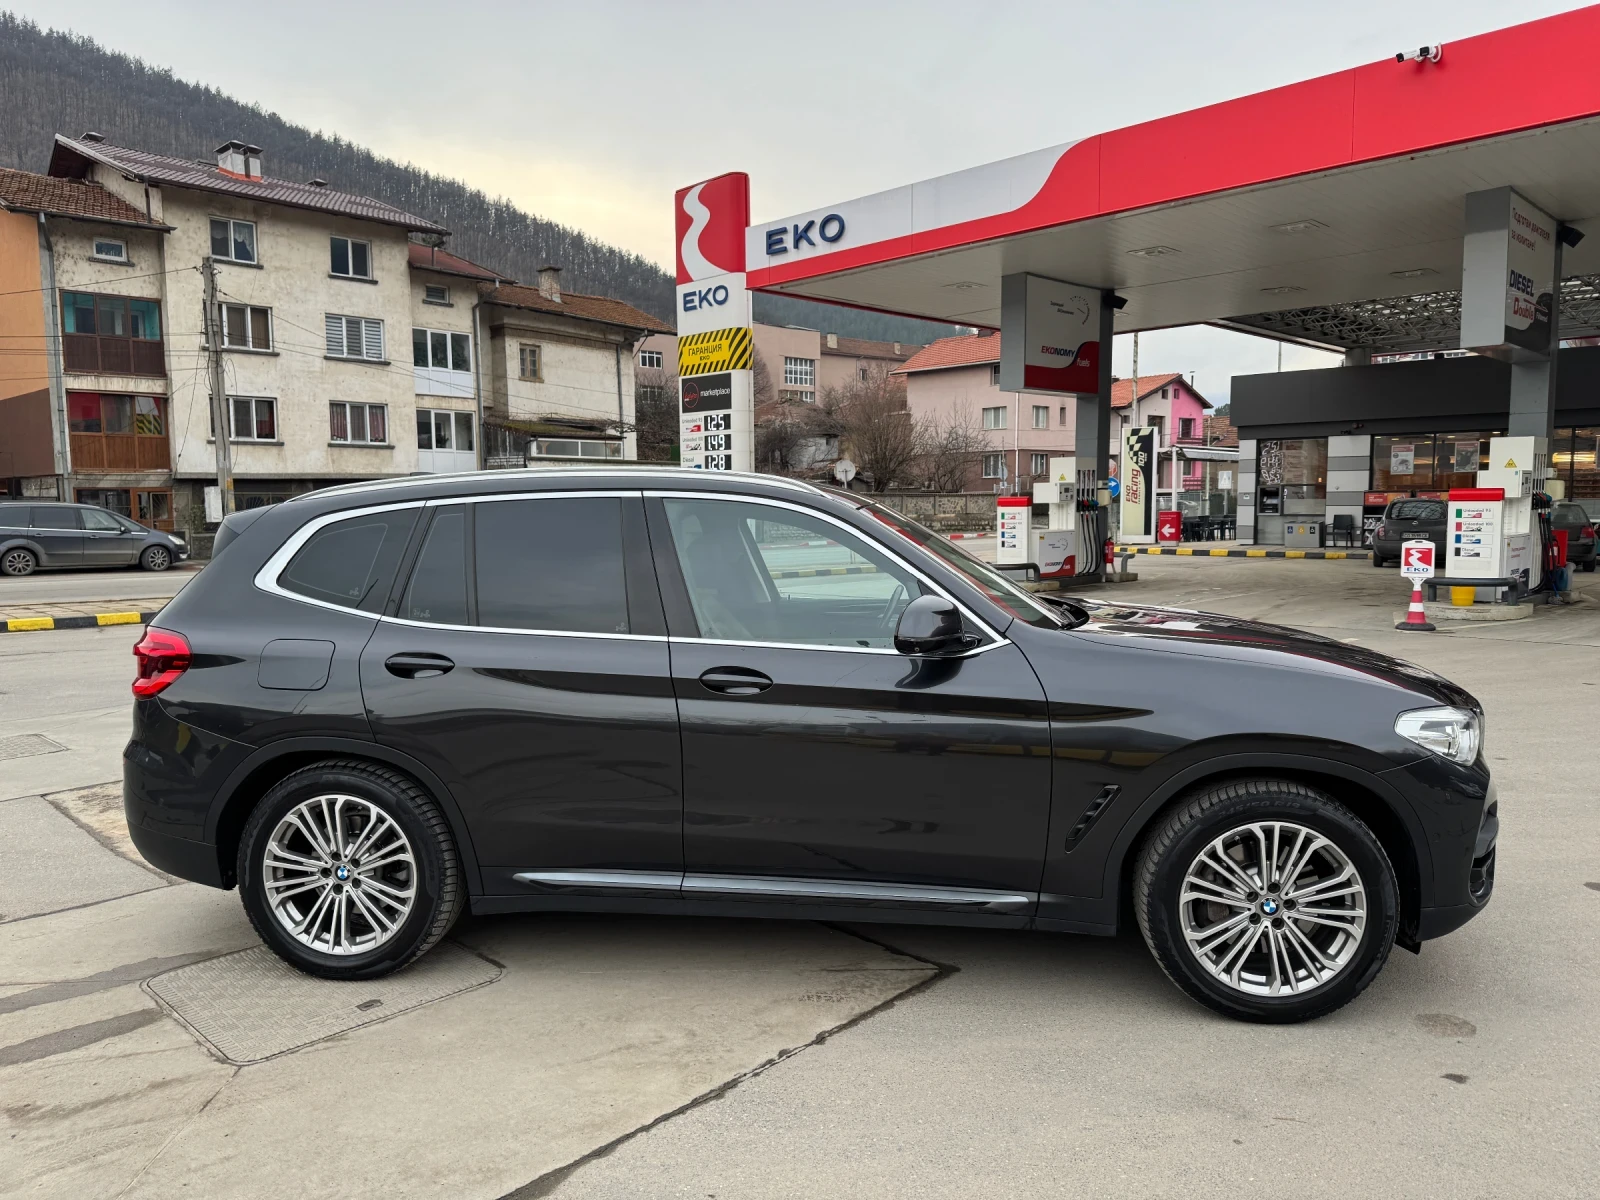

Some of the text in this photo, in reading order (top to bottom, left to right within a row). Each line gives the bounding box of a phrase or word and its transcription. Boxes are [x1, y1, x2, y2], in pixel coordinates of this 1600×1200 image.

[766, 214, 845, 255] EKO
[1509, 269, 1534, 297] DIESEL
[683, 285, 729, 312] EKO
[688, 343, 722, 356] ГАРАНЦИЯ
[1041, 345, 1090, 367] EKONOMY fuels
[700, 388, 730, 397] marketplace
[1130, 469, 1141, 504] racing
